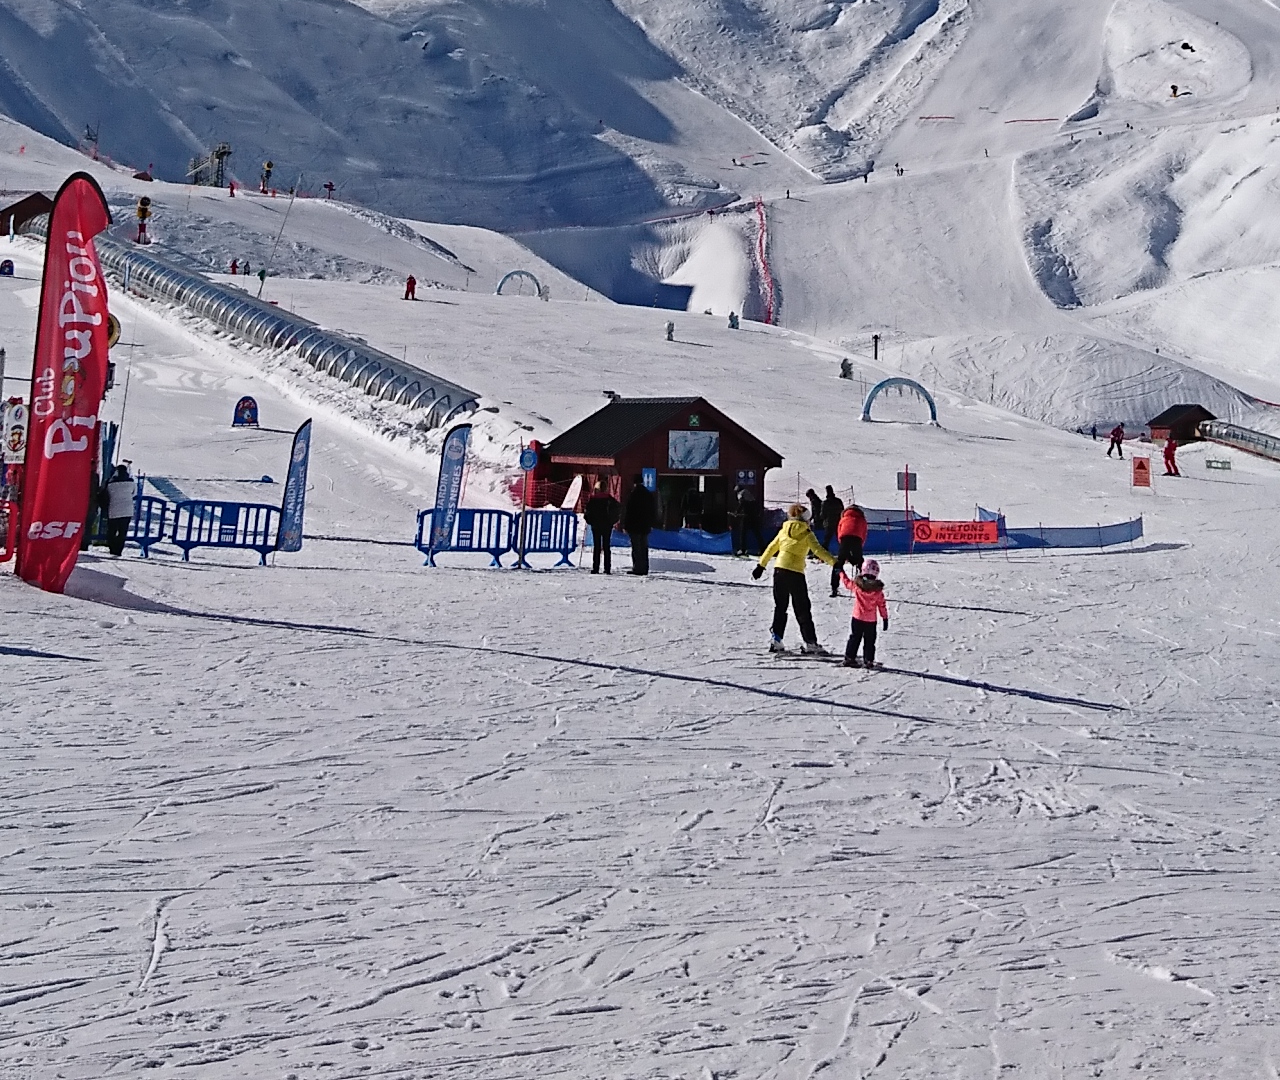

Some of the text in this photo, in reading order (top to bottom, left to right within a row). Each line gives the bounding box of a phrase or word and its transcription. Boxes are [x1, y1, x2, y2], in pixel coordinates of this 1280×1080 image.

[34, 366, 56, 416] Club
[286, 477, 296, 513] JARDIN
[436, 473, 449, 510] JARDIN
[446, 465, 461, 522] DES NEIGES
[935, 533, 991, 541] INTERDITS
